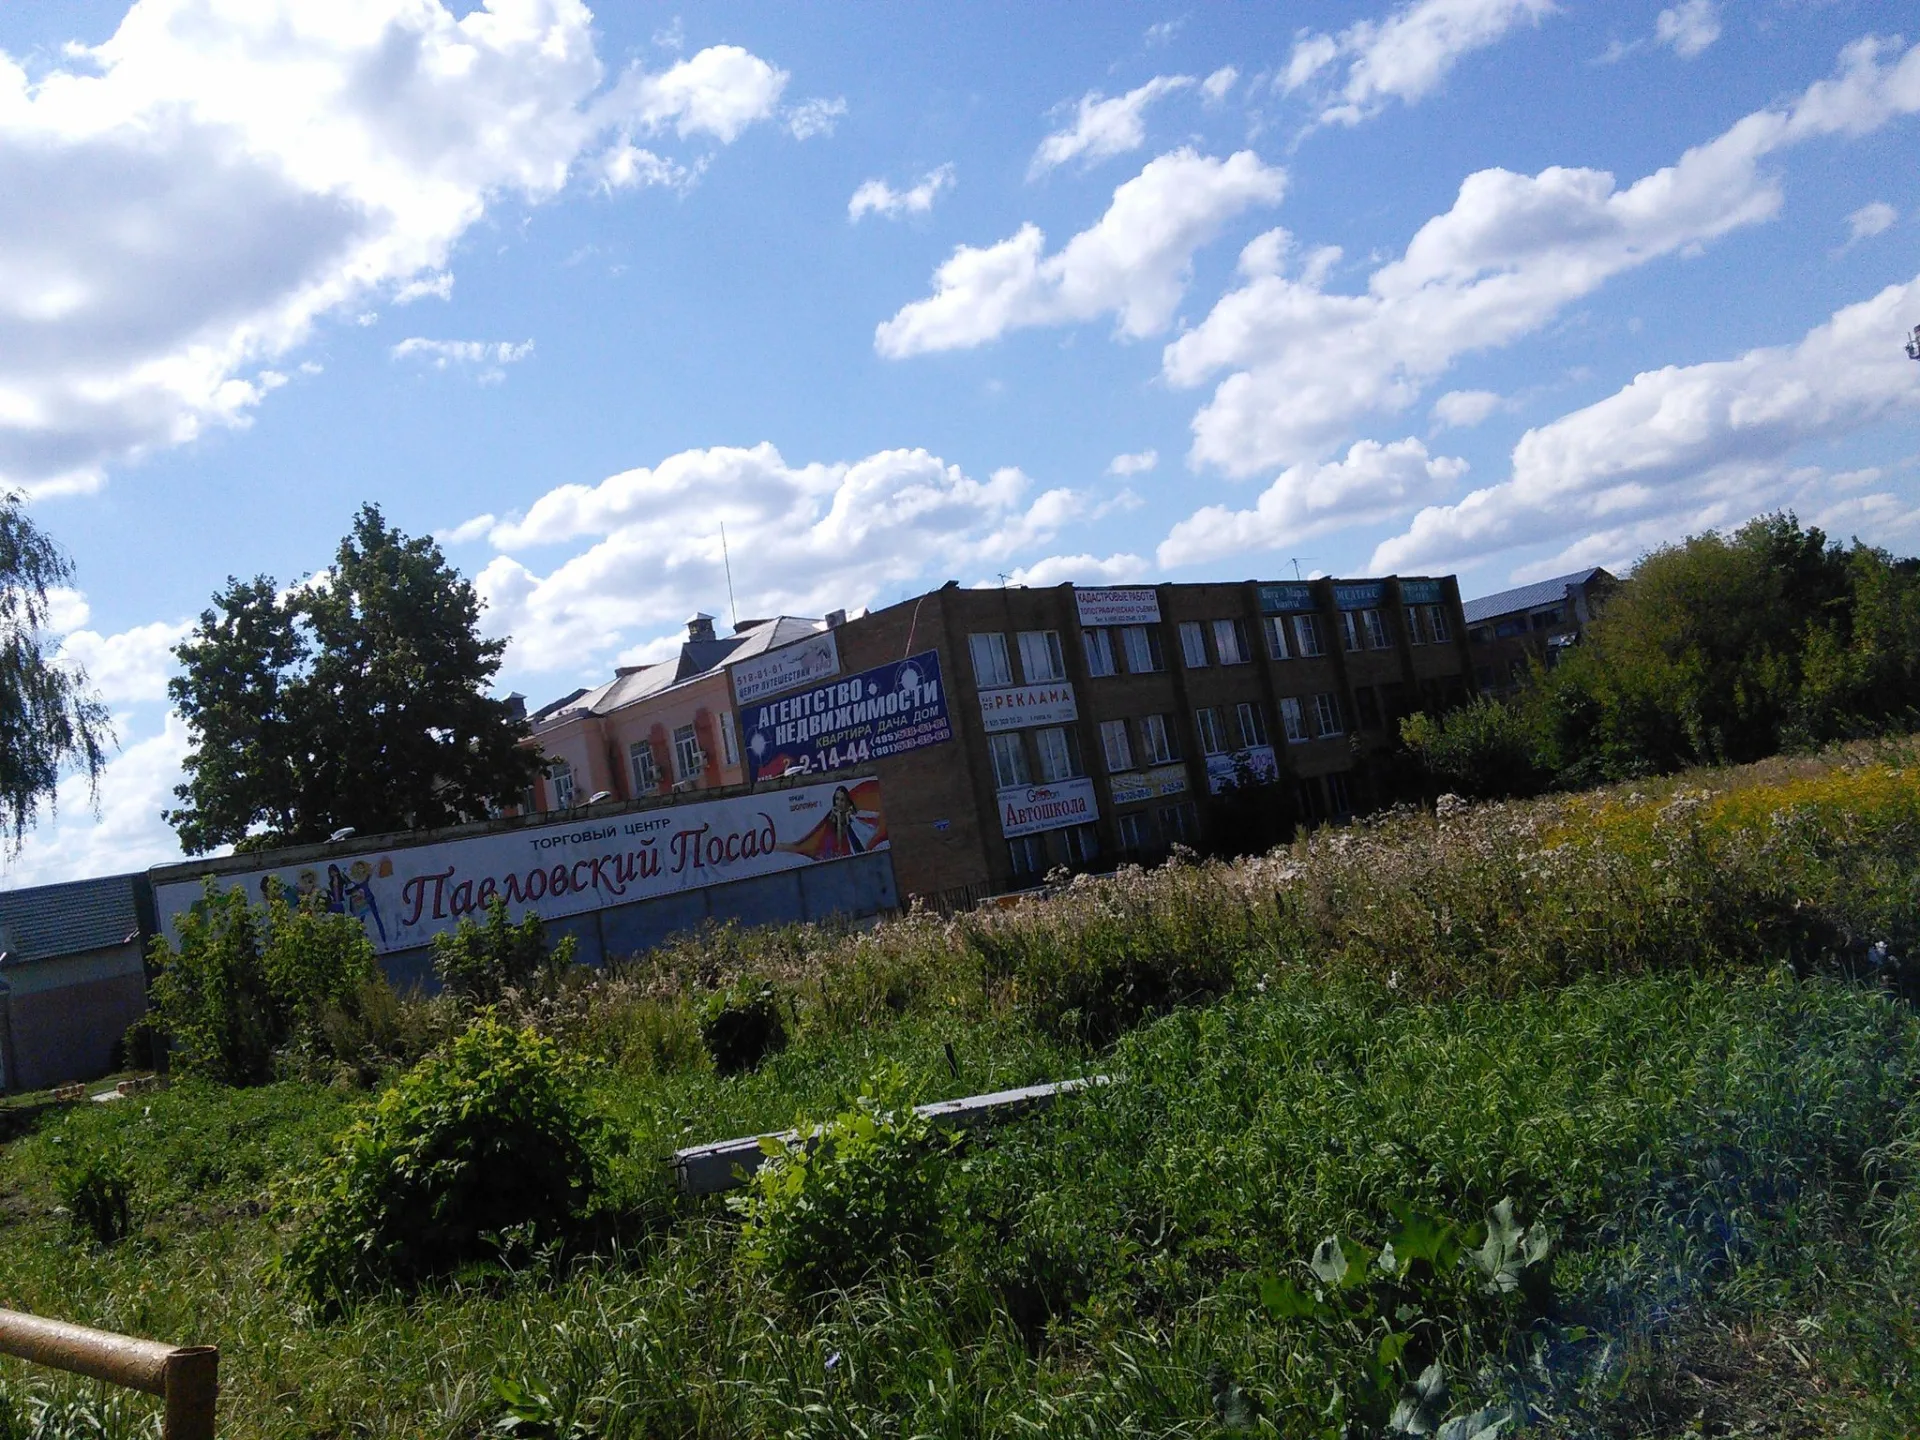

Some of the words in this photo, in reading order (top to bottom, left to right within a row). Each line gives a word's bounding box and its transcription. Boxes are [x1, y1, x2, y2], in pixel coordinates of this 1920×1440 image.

[1078, 592, 1128, 603] КАДАСТРОВЫЕ
[1129, 591, 1155, 601] РАБОТЫ
[739, 684, 759, 698] ЦЕНТР
[758, 679, 862, 729] АГЕНТСТВО
[995, 689, 1070, 709] РЕКЛАМА
[775, 680, 938, 746] НЕДВИЖИМОСТИ
[816, 725, 872, 749] КВАРТИРА
[878, 715, 908, 735] ДАЧА
[913, 706, 938, 726] ДОМ
[799, 739, 870, 775] 2-14-44
[1006, 797, 1087, 827] Автошкола
[530, 825, 617, 851] ТОРГОВЫЙ
[625, 818, 671, 837] ЦЕНТР
[402, 838, 662, 926] Павловский
[671, 812, 777, 873] Посад
